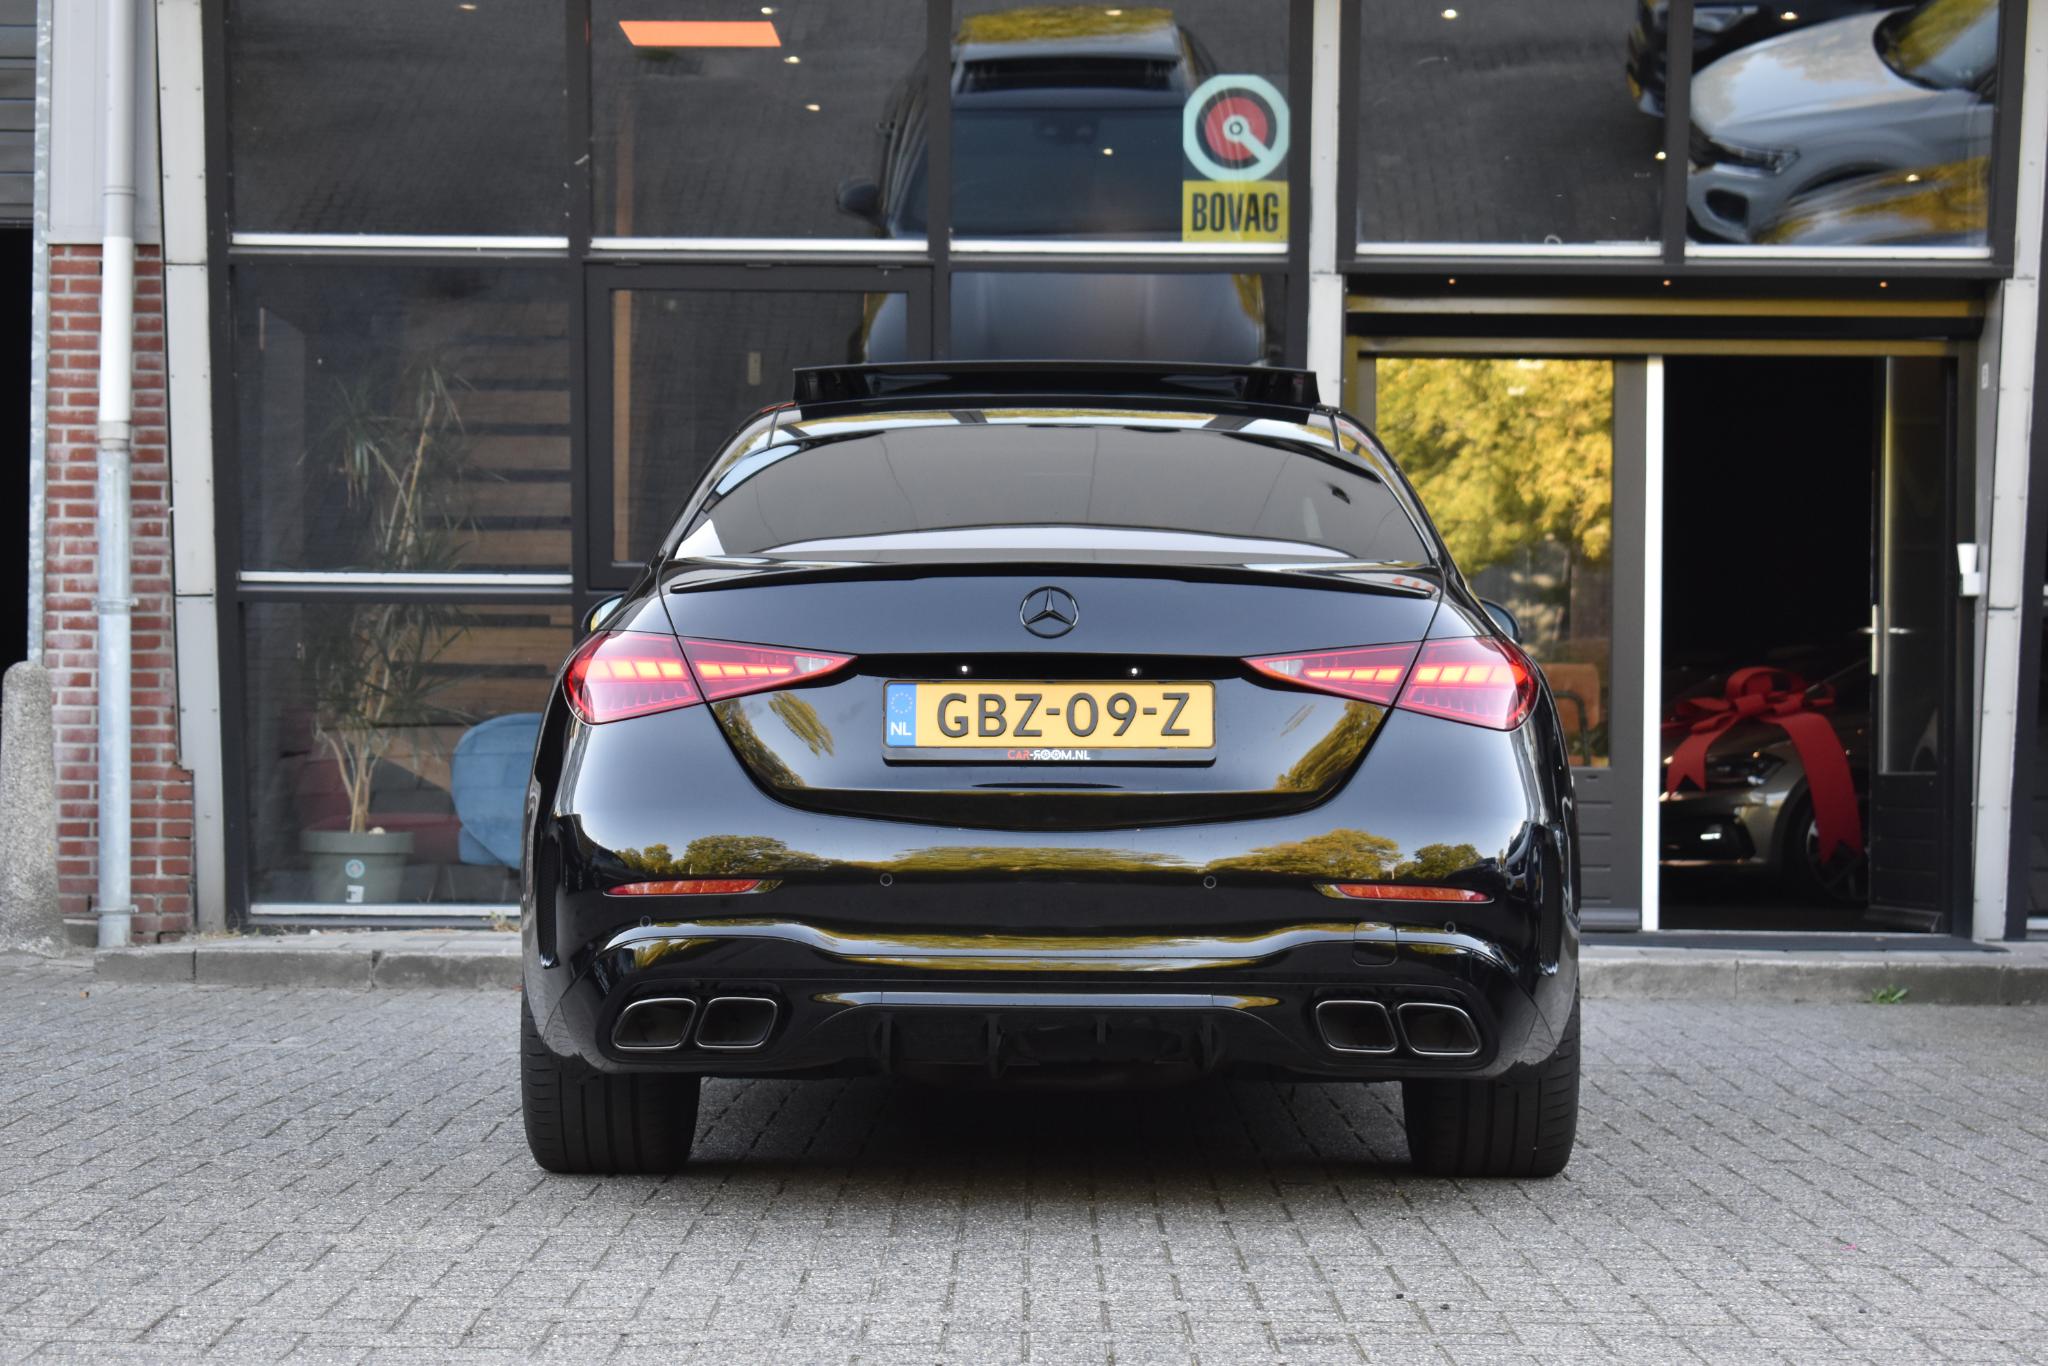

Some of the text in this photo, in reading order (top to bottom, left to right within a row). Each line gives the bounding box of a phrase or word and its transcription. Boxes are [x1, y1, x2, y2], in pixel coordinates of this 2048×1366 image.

[1192, 192, 1279, 232] BOVAG
[891, 722, 912, 736] NL
[937, 692, 1190, 737] GBZ-09-Z
